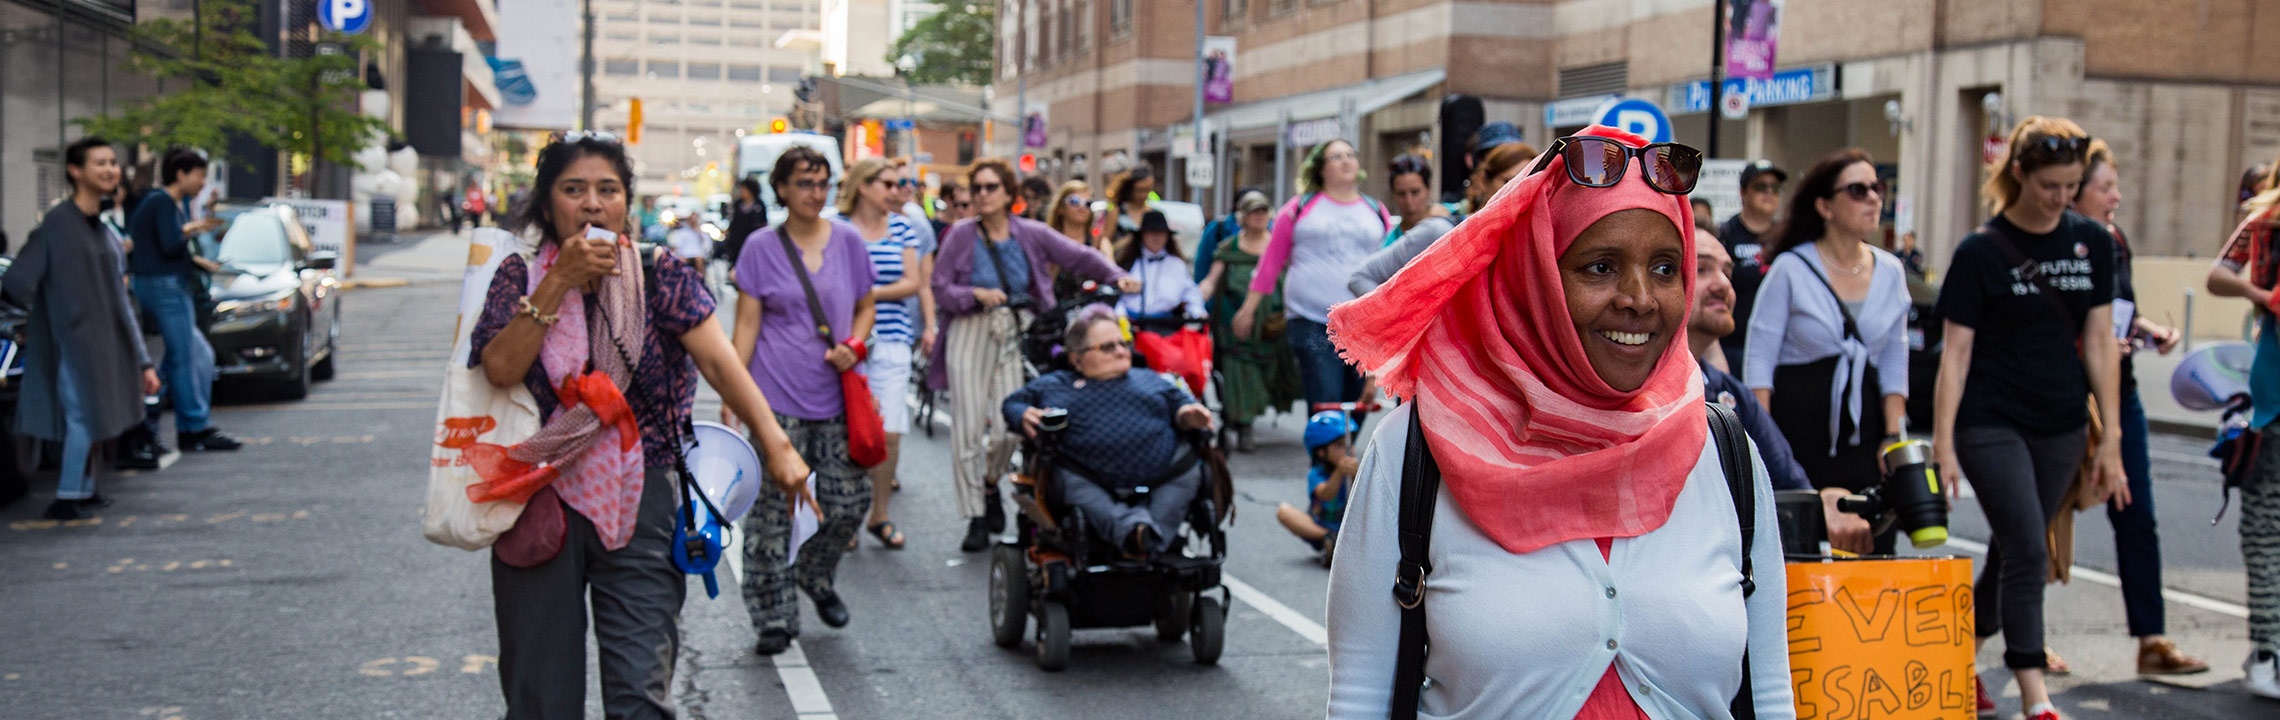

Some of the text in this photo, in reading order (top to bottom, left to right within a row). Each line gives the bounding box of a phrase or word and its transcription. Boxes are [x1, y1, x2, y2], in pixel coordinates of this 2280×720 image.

[331, 0, 365, 30] P
[1745, 75, 1810, 105] PARKING
[1617, 109, 1659, 147] P
